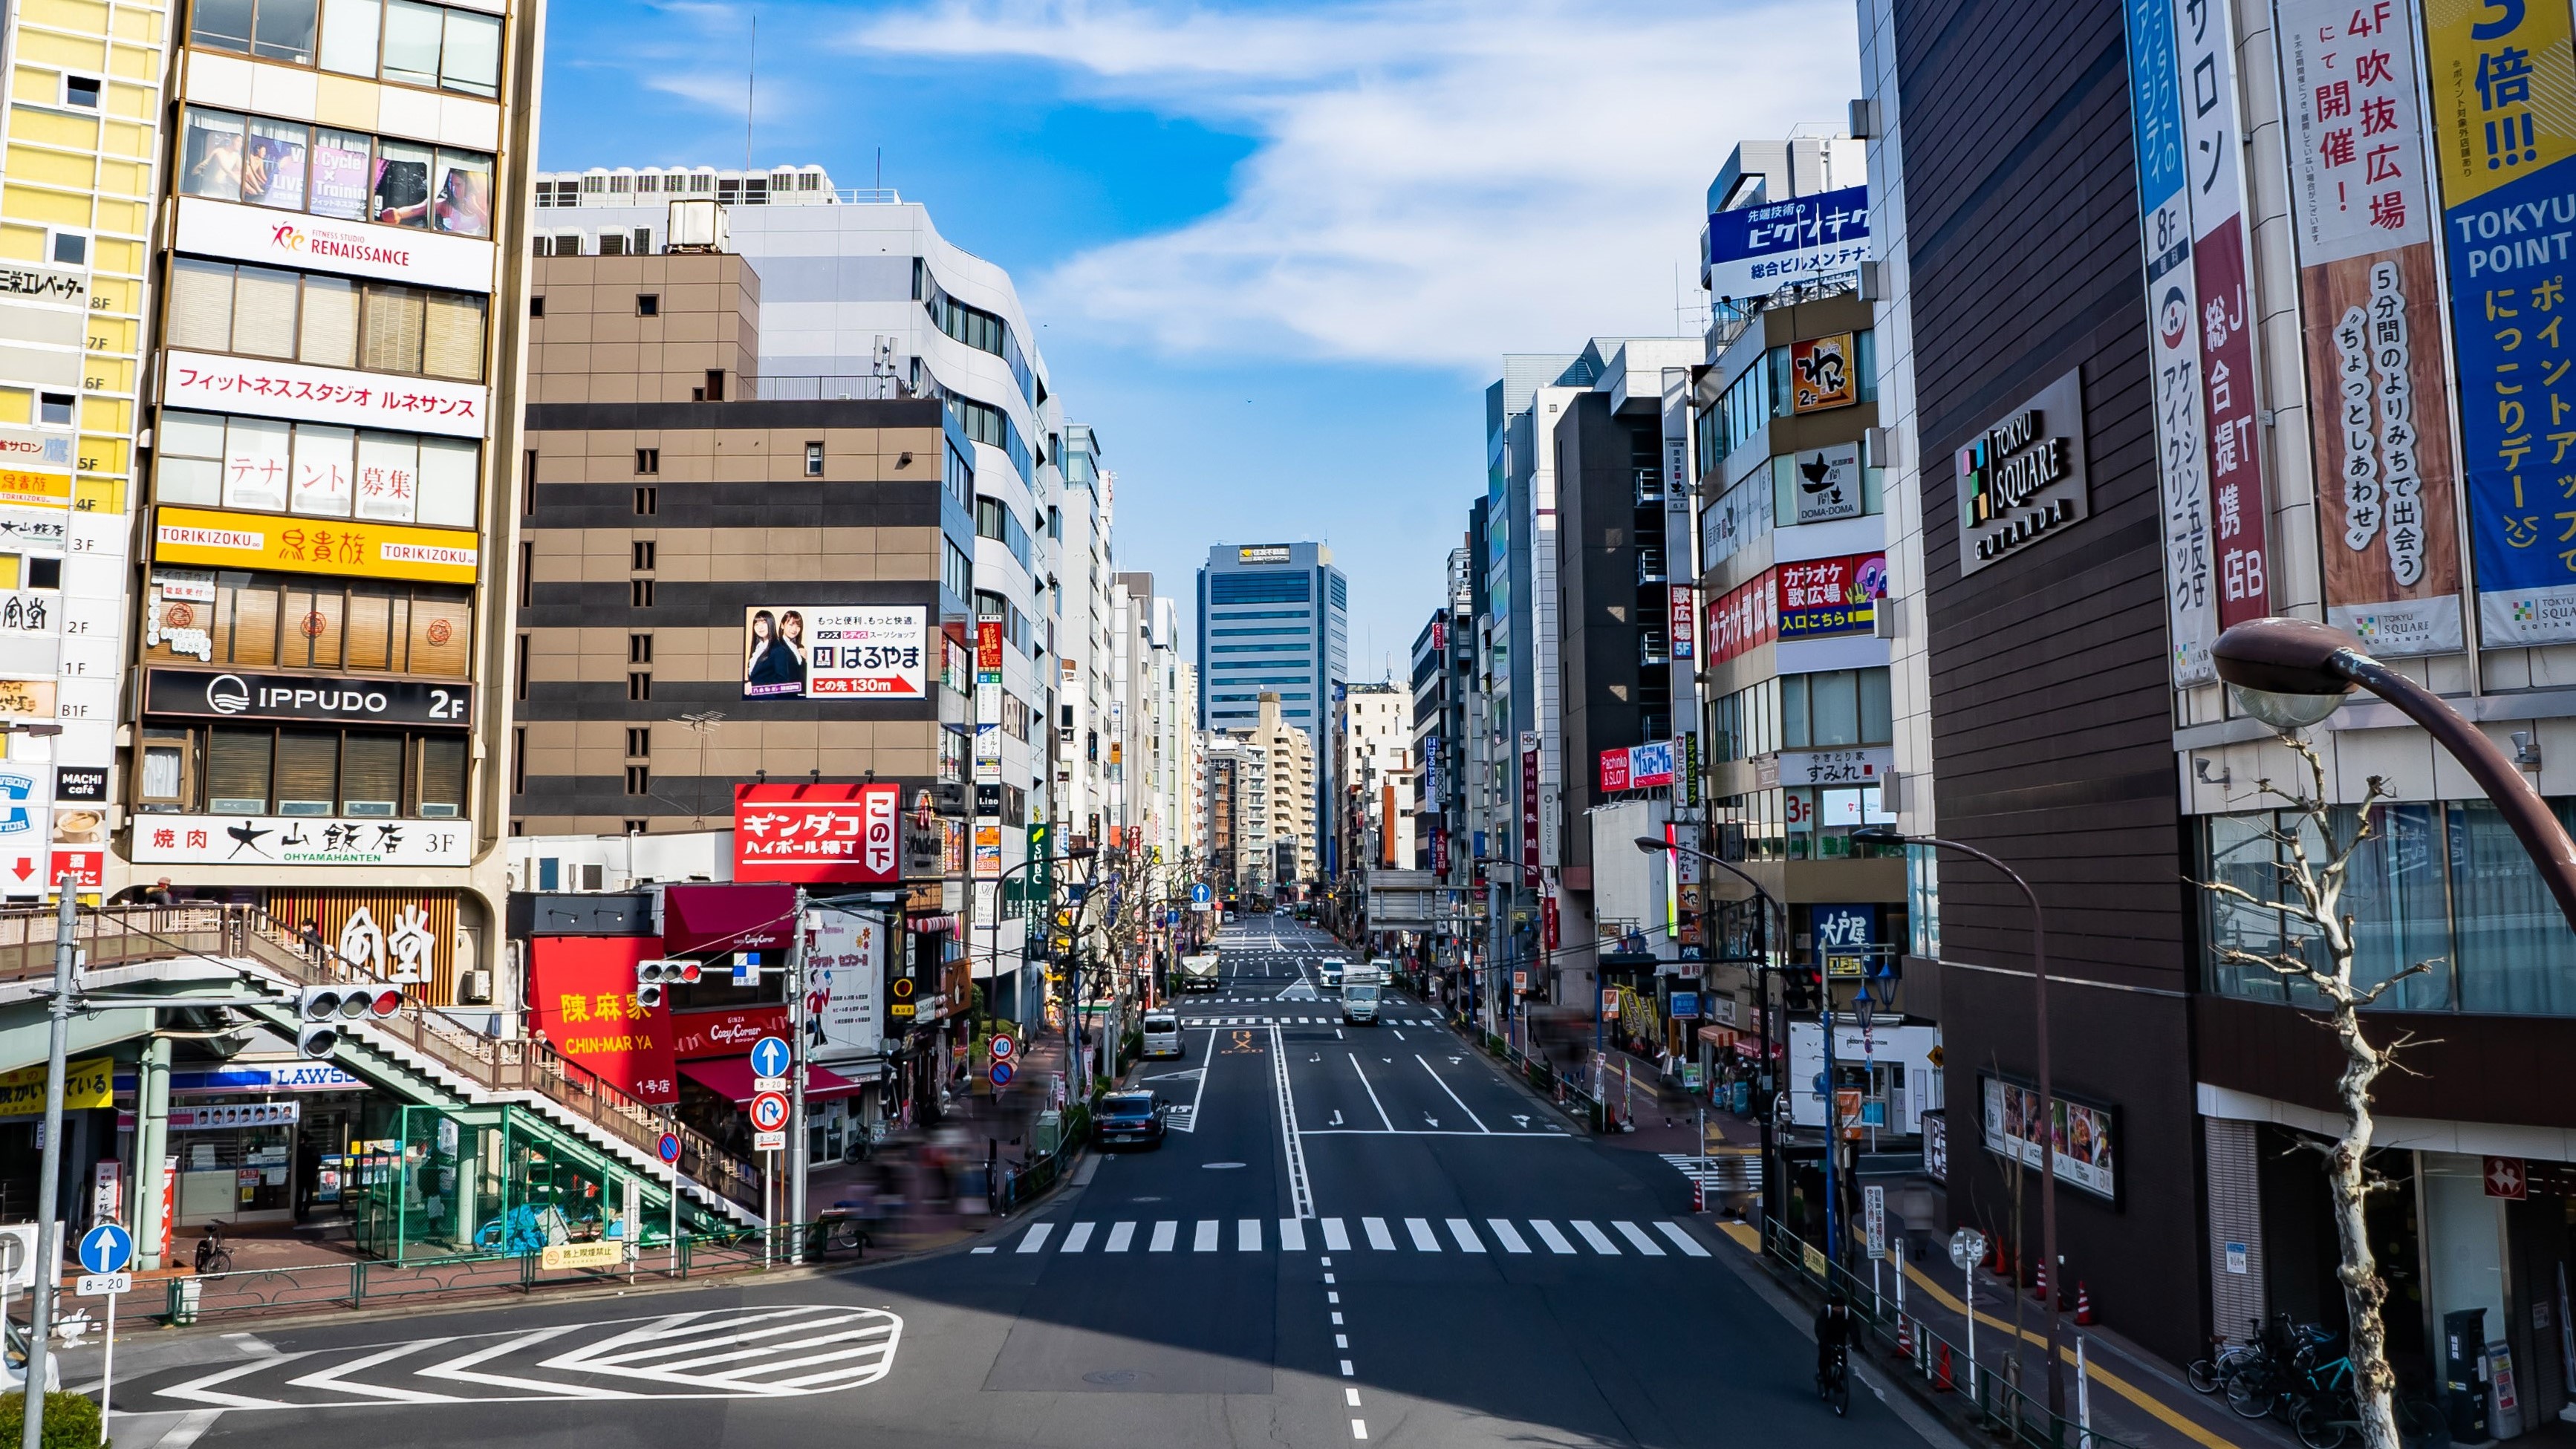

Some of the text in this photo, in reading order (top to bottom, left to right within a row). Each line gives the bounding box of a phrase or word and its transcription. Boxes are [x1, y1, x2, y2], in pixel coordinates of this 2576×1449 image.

[322, 151, 362, 171] Cycle
[273, 173, 303, 193] LIVE
[1748, 202, 1805, 223] 先端技術の
[2455, 194, 2575, 243] TOKYU
[312, 229, 365, 244] FITNESS STUDIO
[2157, 207, 2176, 253] 8F
[311, 238, 410, 267] RENAISSANCE
[2468, 232, 2572, 278] POINT
[0, 270, 84, 299] 三栄エレベーター
[91, 296, 111, 309] 8F
[88, 336, 108, 350] 7F
[85, 377, 105, 390] 6F
[179, 368, 475, 418] フィットネススタジオ ルネサンス
[1798, 389, 1818, 406] 2F
[2484, 288, 2531, 508] にっこりデー
[2374, 268, 2417, 578] 5分間のよりみちで出会う
[1994, 410, 2032, 458] TOKYU
[2205, 294, 2245, 602] 総合提携店
[79, 458, 98, 470] 5F
[1997, 438, 2059, 509] SQUARE
[230, 458, 412, 500] テナント募集
[2162, 364, 2189, 613] アイクリニック
[2177, 359, 2205, 608] ケイシン五反田
[1, 492, 46, 503] TORIKIZOKU
[76, 498, 97, 511] 4F
[1, 521, 65, 538] 大山飯店
[161, 527, 251, 547] TORIKIZOKU
[1974, 499, 2062, 561] GOTANDA
[74, 538, 94, 551] 3F
[279, 527, 365, 565] 鳥貴族
[384, 544, 467, 564] TORIKIZOKU
[1783, 563, 1844, 588] カラオケ
[1786, 582, 1841, 608] 歌広場
[2542, 598, 2575, 607] TOKYU
[0, 596, 47, 631] 風堂
[1672, 585, 1691, 641] 歌広場
[1710, 579, 1777, 654] カラオケ歌広場
[1781, 610, 1845, 631] 入口こちら
[68, 621, 88, 634] 2F
[2384, 622, 2429, 634] SQUARE
[1675, 642, 1691, 657] 5F
[2364, 634, 2430, 645] GOTANDA
[842, 646, 920, 668] はるやま
[65, 662, 86, 675] 1F
[816, 679, 891, 691] この先 130m
[62, 704, 88, 717] B1F
[258, 687, 465, 719] IPPUDO 2F
[1602, 754, 1627, 770] Pachinko
[1812, 751, 1865, 763] やきとり家
[62, 773, 102, 785] MACHI
[1609, 769, 1625, 785] SLOT
[1687, 735, 1697, 804] シティクリニック
[1806, 763, 1860, 782] すみれ
[68, 784, 94, 795] café
[1787, 795, 1811, 823] 3F
[743, 811, 859, 838] ギンダコ
[870, 798, 891, 868] この下
[153, 820, 455, 861] 焼肉 大山飯店 3F
[744, 839, 856, 855] ハイボール横丁
[69, 853, 86, 869] 酒
[284, 852, 381, 863] OHYAMAHANTEN
[1437, 834, 1446, 870] 大阪王将
[1032, 844, 1043, 885] SMBC
[559, 991, 652, 1023] 陳麻家
[710, 1024, 761, 1044] Cozy Corner
[565, 1035, 654, 1055] CHIN-MAR YA
[995, 1041, 1009, 1052] 40
[636, 1079, 671, 1095] 1号店
[563, 1247, 613, 1259] 路上喫煙禁止
